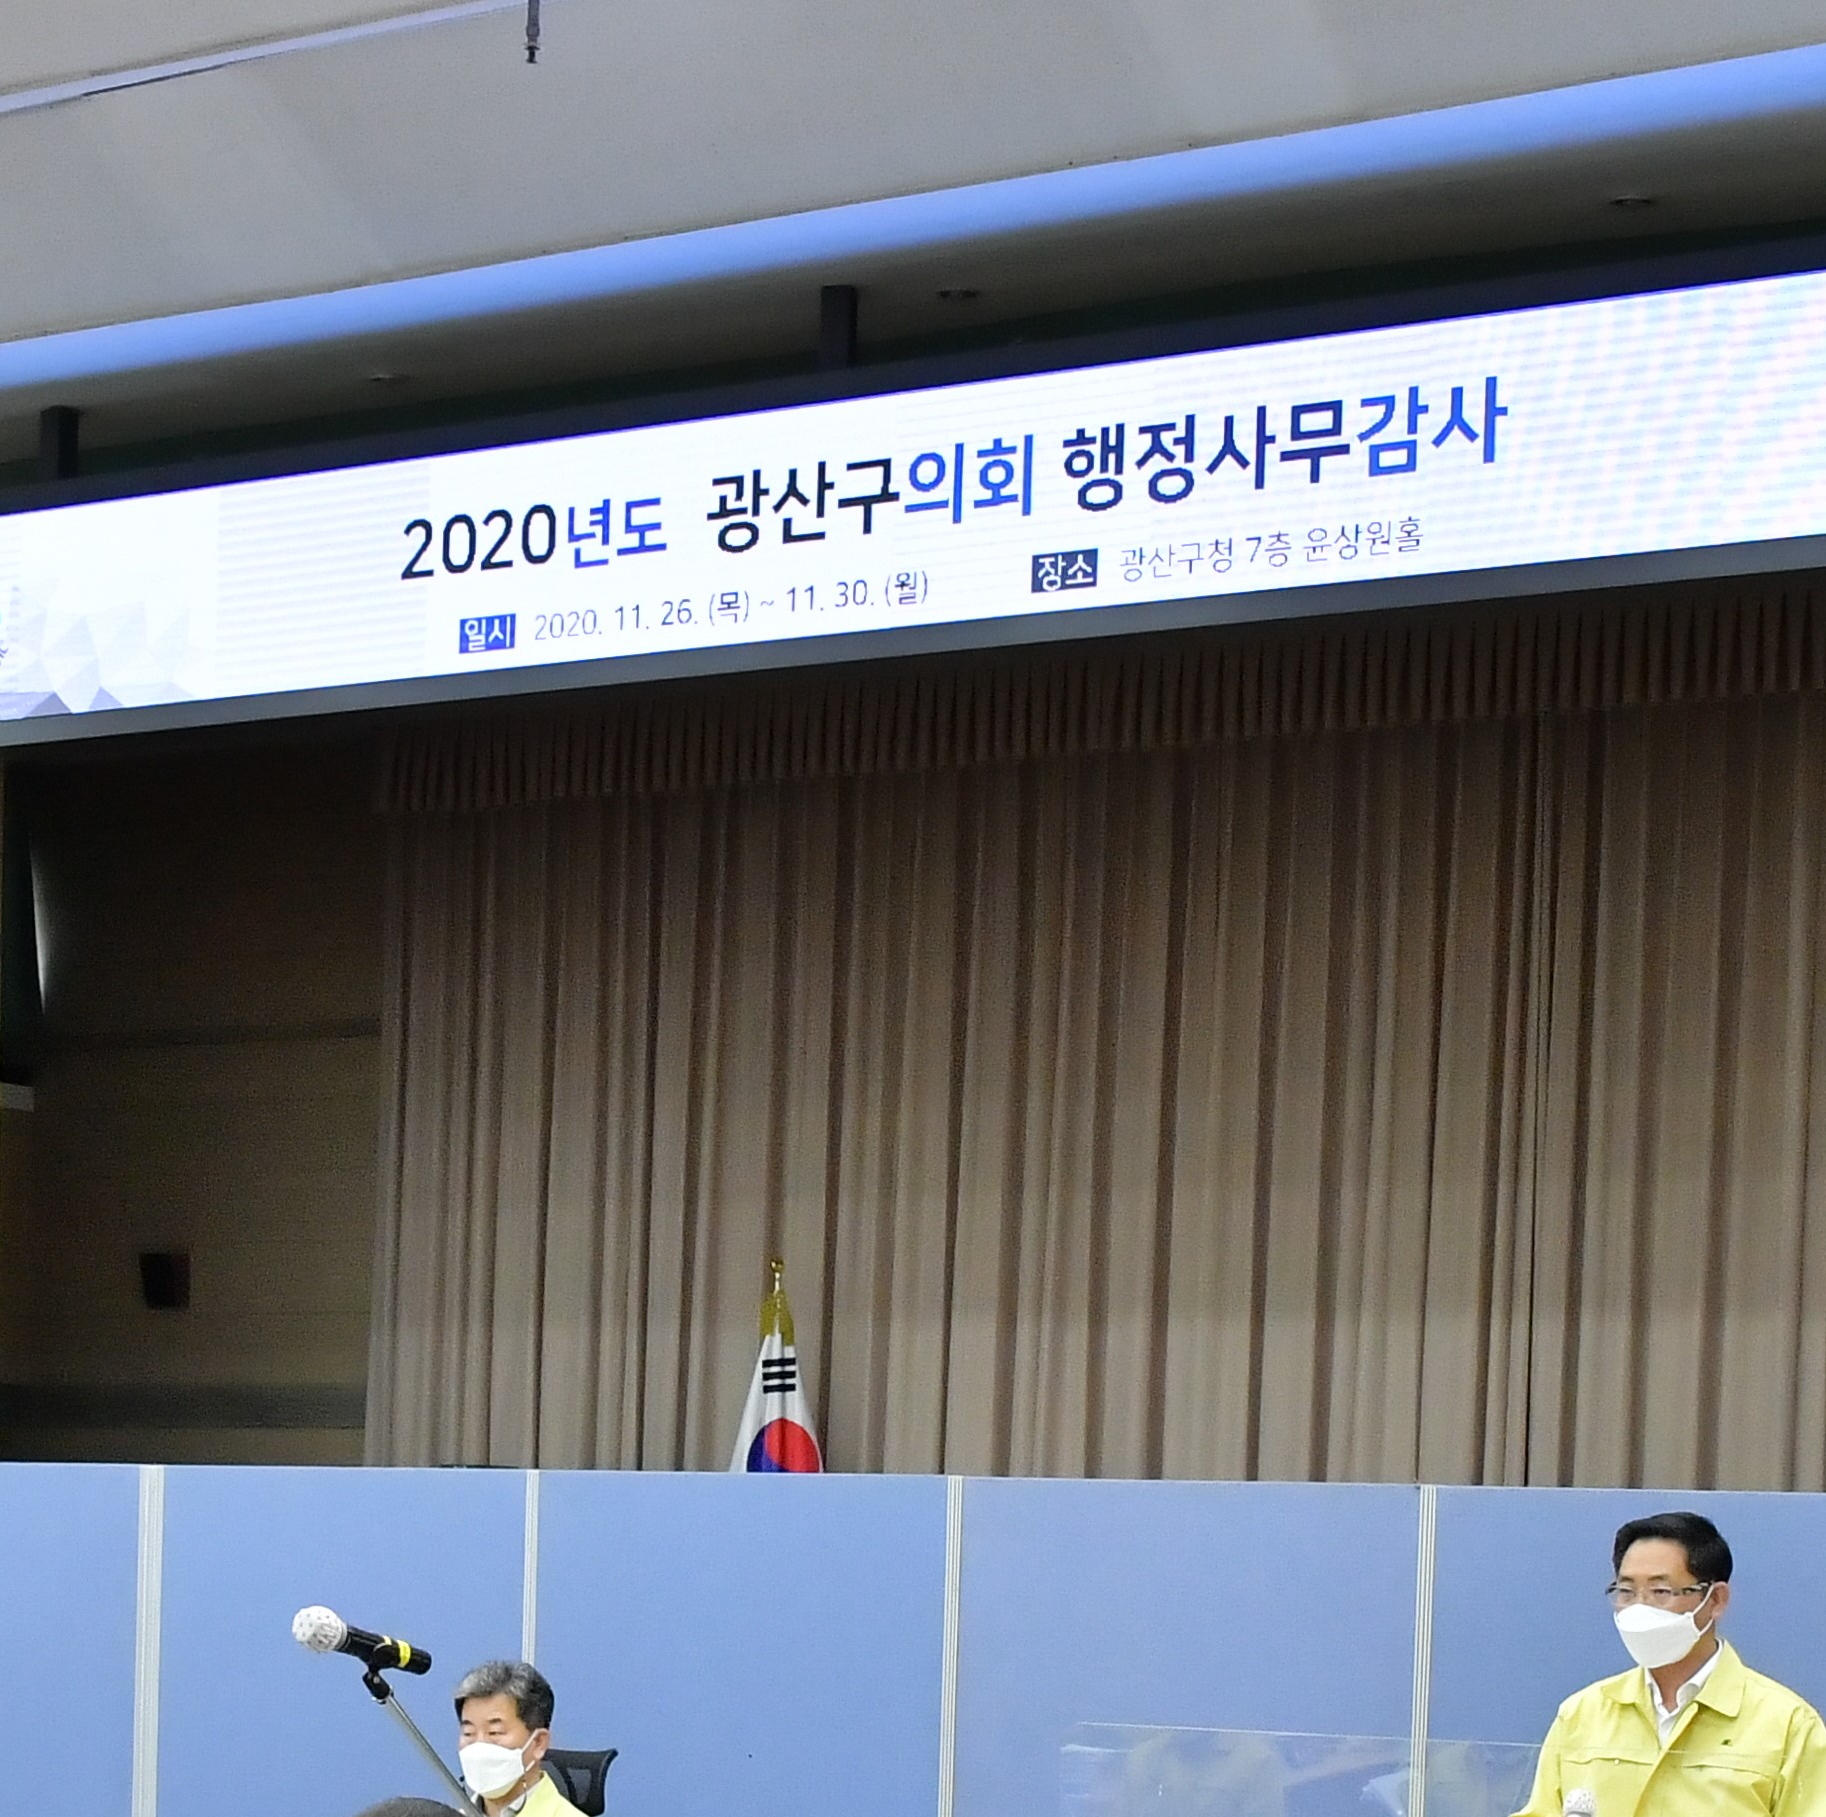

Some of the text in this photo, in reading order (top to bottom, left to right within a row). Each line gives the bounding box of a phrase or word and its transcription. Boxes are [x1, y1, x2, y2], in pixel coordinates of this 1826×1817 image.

[401, 376, 1508, 580] 2020년도 광산구의회 행정사무감사
[1037, 515, 1423, 591] 장소 광산구청 7층 윤상원홀
[463, 616, 516, 652] 일시
[534, 610, 603, 641] 2020.
[614, 604, 649, 630] 11.
